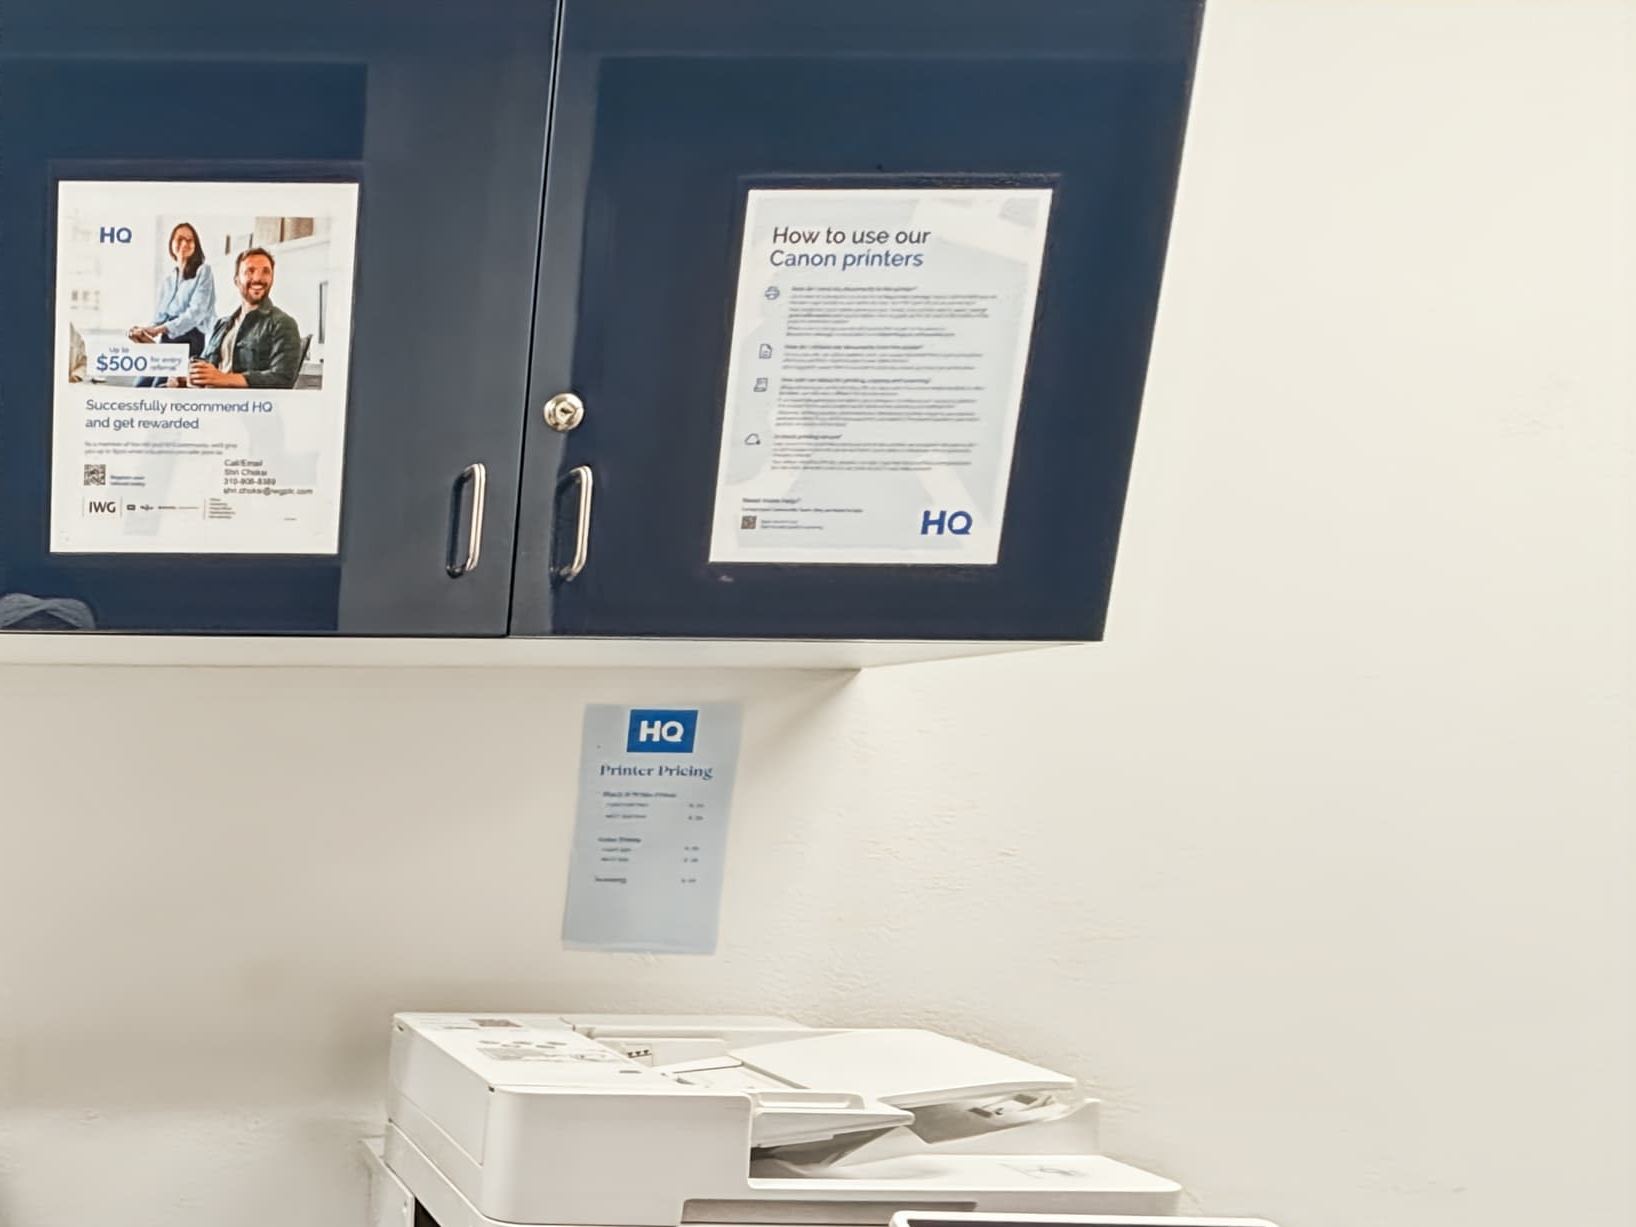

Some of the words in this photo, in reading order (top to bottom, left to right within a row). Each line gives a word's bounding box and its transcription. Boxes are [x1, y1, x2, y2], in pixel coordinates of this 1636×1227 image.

[99, 226, 132, 244] HQ
[772, 226, 820, 244] How
[826, 226, 846, 244] to
[852, 230, 889, 244] use
[895, 230, 931, 244] our
[770, 250, 837, 267] Canon
[842, 248, 924, 271] printers
[96, 353, 148, 372] $500
[86, 399, 166, 414] Successfully
[170, 401, 249, 412] recommend
[252, 401, 273, 413] HQ
[85, 417, 110, 429] and
[114, 418, 134, 431] get
[138, 418, 199, 429] rewarded
[89, 501, 116, 513] IWG
[921, 510, 973, 535] HQ
[639, 720, 684, 742] HQ
[599, 764, 654, 777] Printer
[658, 765, 713, 781] Pricing
